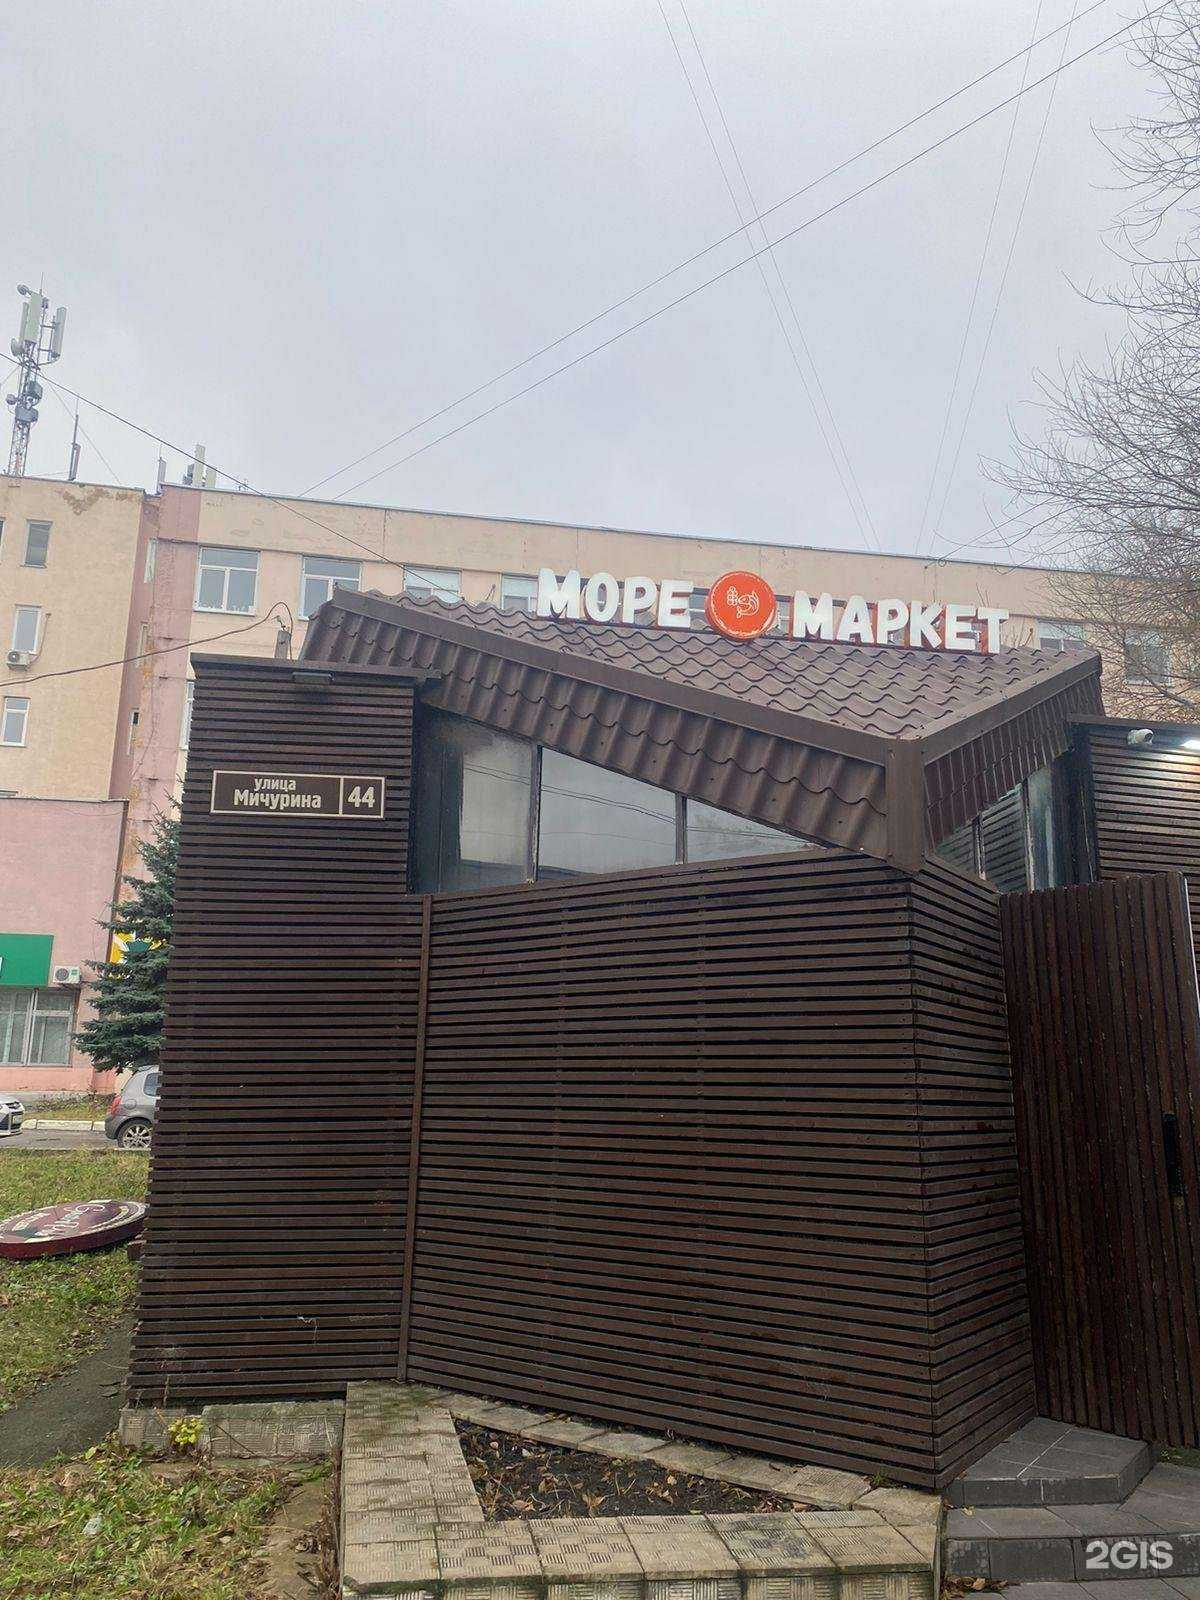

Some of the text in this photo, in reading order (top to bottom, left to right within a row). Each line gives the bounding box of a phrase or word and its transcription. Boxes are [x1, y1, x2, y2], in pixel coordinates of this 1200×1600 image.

[535, 567, 1010, 655] МОРЕ МАРКЕТ
[253, 777, 297, 792] улица
[233, 788, 322, 811] Мичурина
[347, 785, 376, 808] 44
